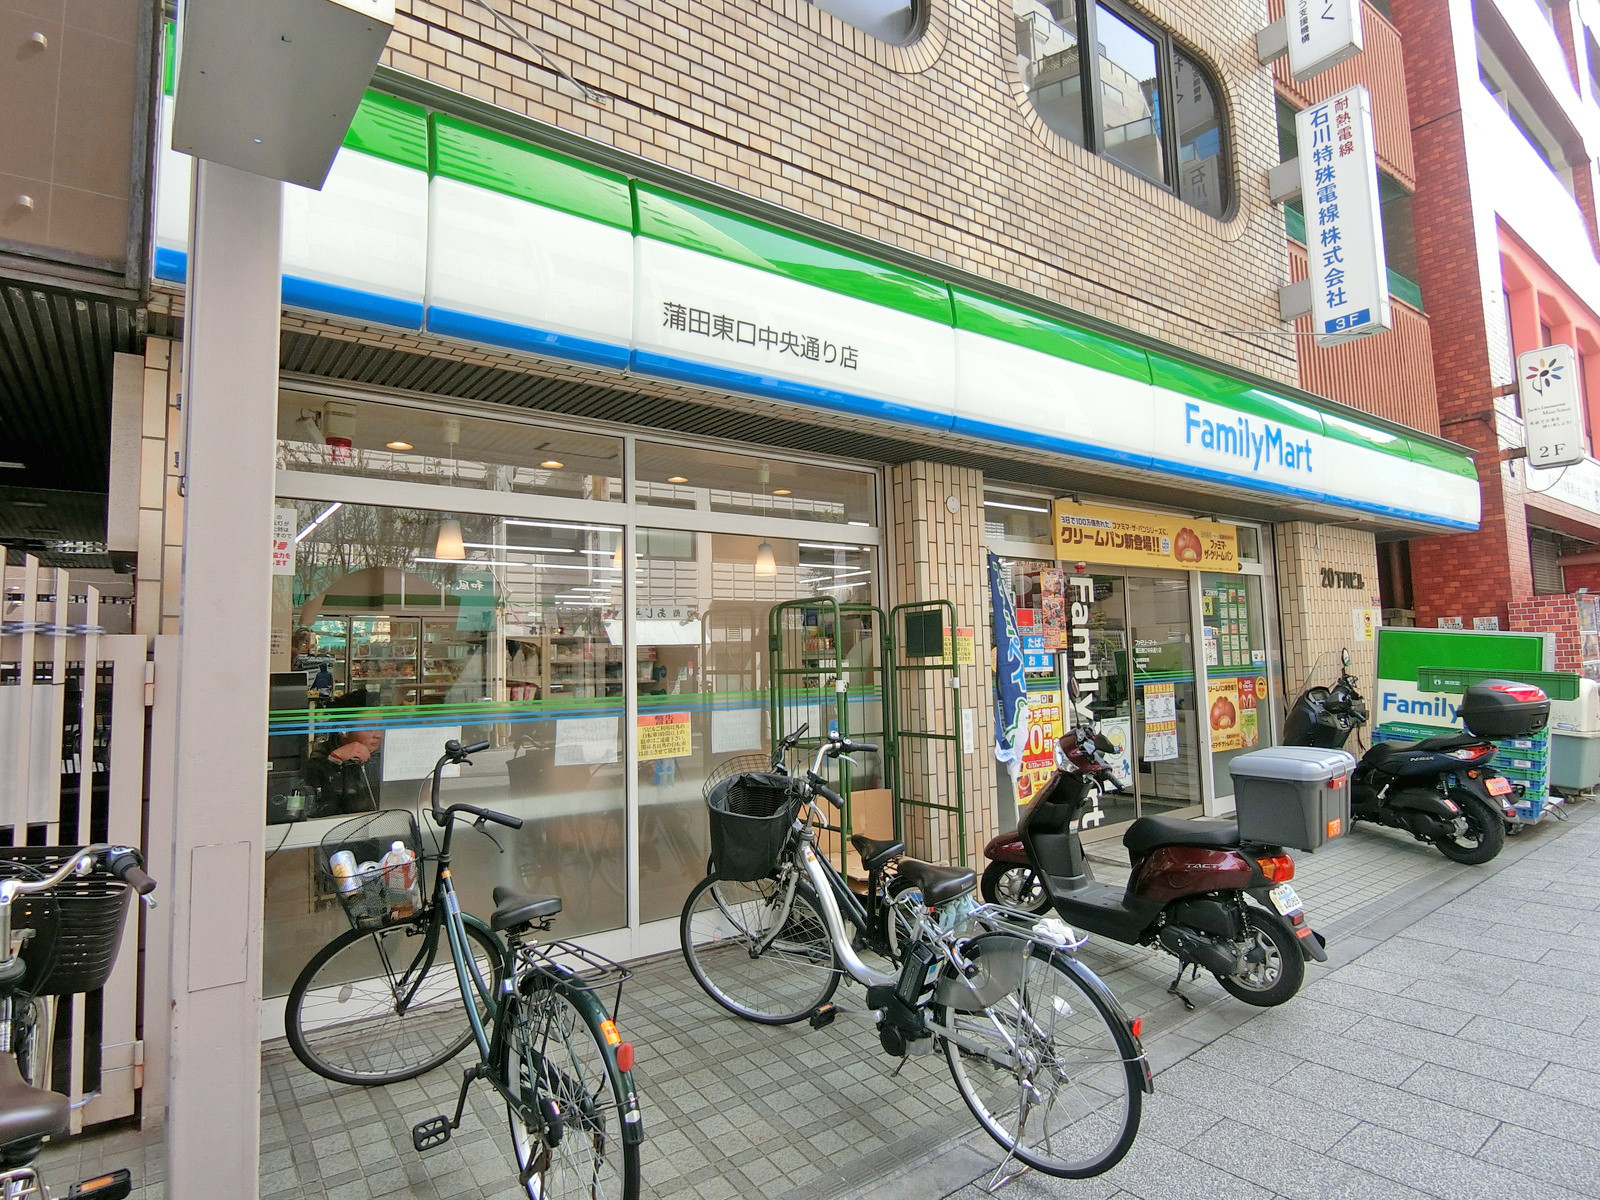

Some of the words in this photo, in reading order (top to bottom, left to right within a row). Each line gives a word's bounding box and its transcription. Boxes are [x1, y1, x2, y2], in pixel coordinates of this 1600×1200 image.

[1334, 95, 1354, 158] 耐熱電線
[1310, 105, 1348, 309] 石川特殊電線株式会社
[662, 301, 859, 371] 蒲田東口中央通り店
[1335, 312, 1359, 330] 3F
[1185, 402, 1313, 473] FamilyMart
[1539, 443, 1566, 458] 2F
[1028, 637, 1044, 648] たば
